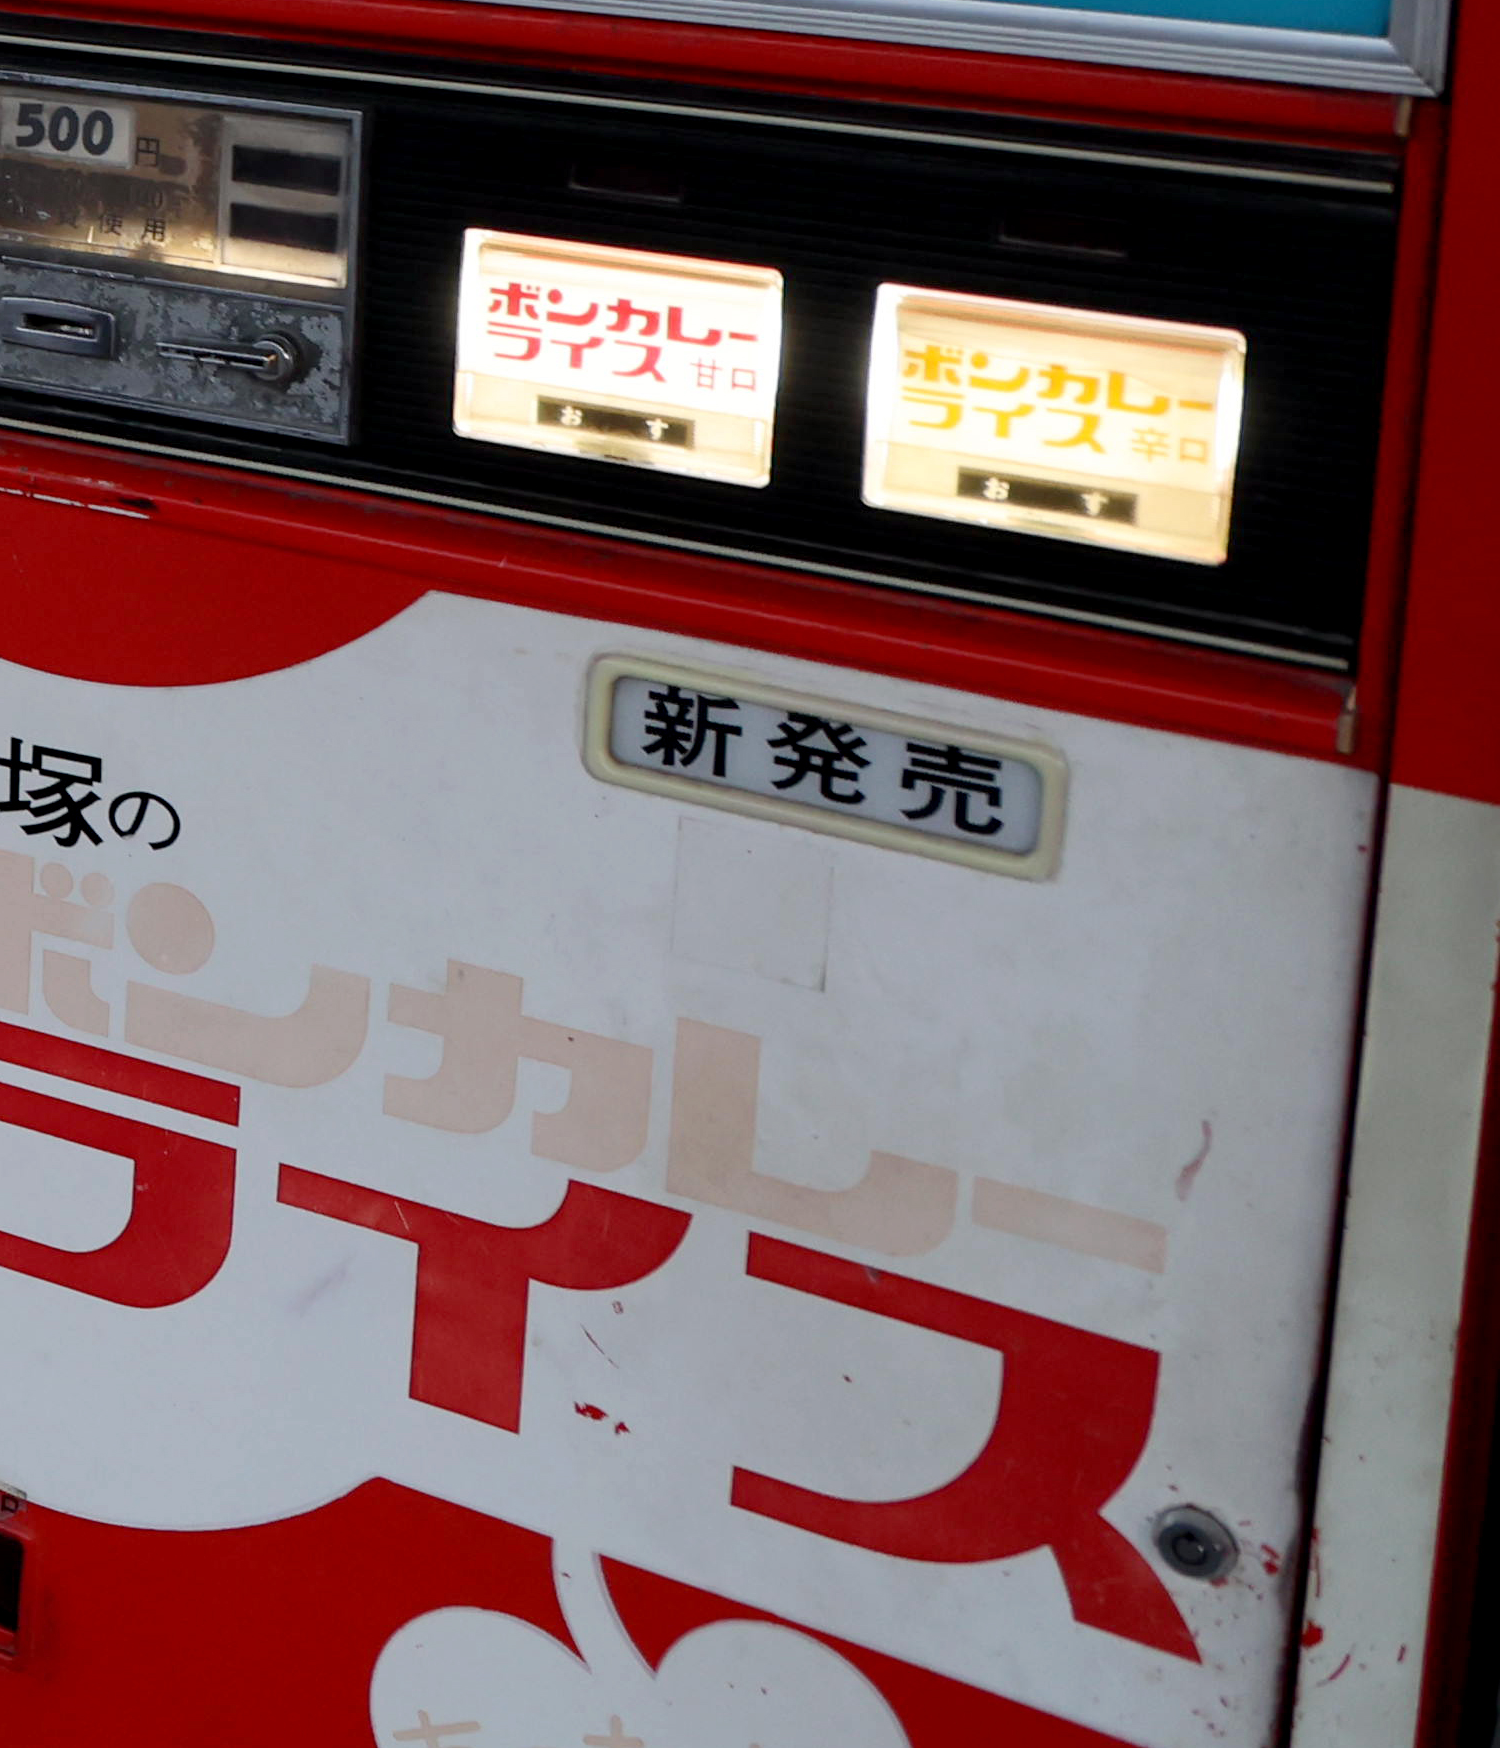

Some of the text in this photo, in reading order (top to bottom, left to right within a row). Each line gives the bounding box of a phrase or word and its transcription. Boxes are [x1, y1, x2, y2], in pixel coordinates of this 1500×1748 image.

[489, 282, 758, 347] ボンカレー
[487, 321, 757, 391] ライス 甘口
[903, 344, 1214, 415] ボンカレー
[902, 386, 1210, 465] ライス 辛口
[642, 684, 1003, 836] 新発売
